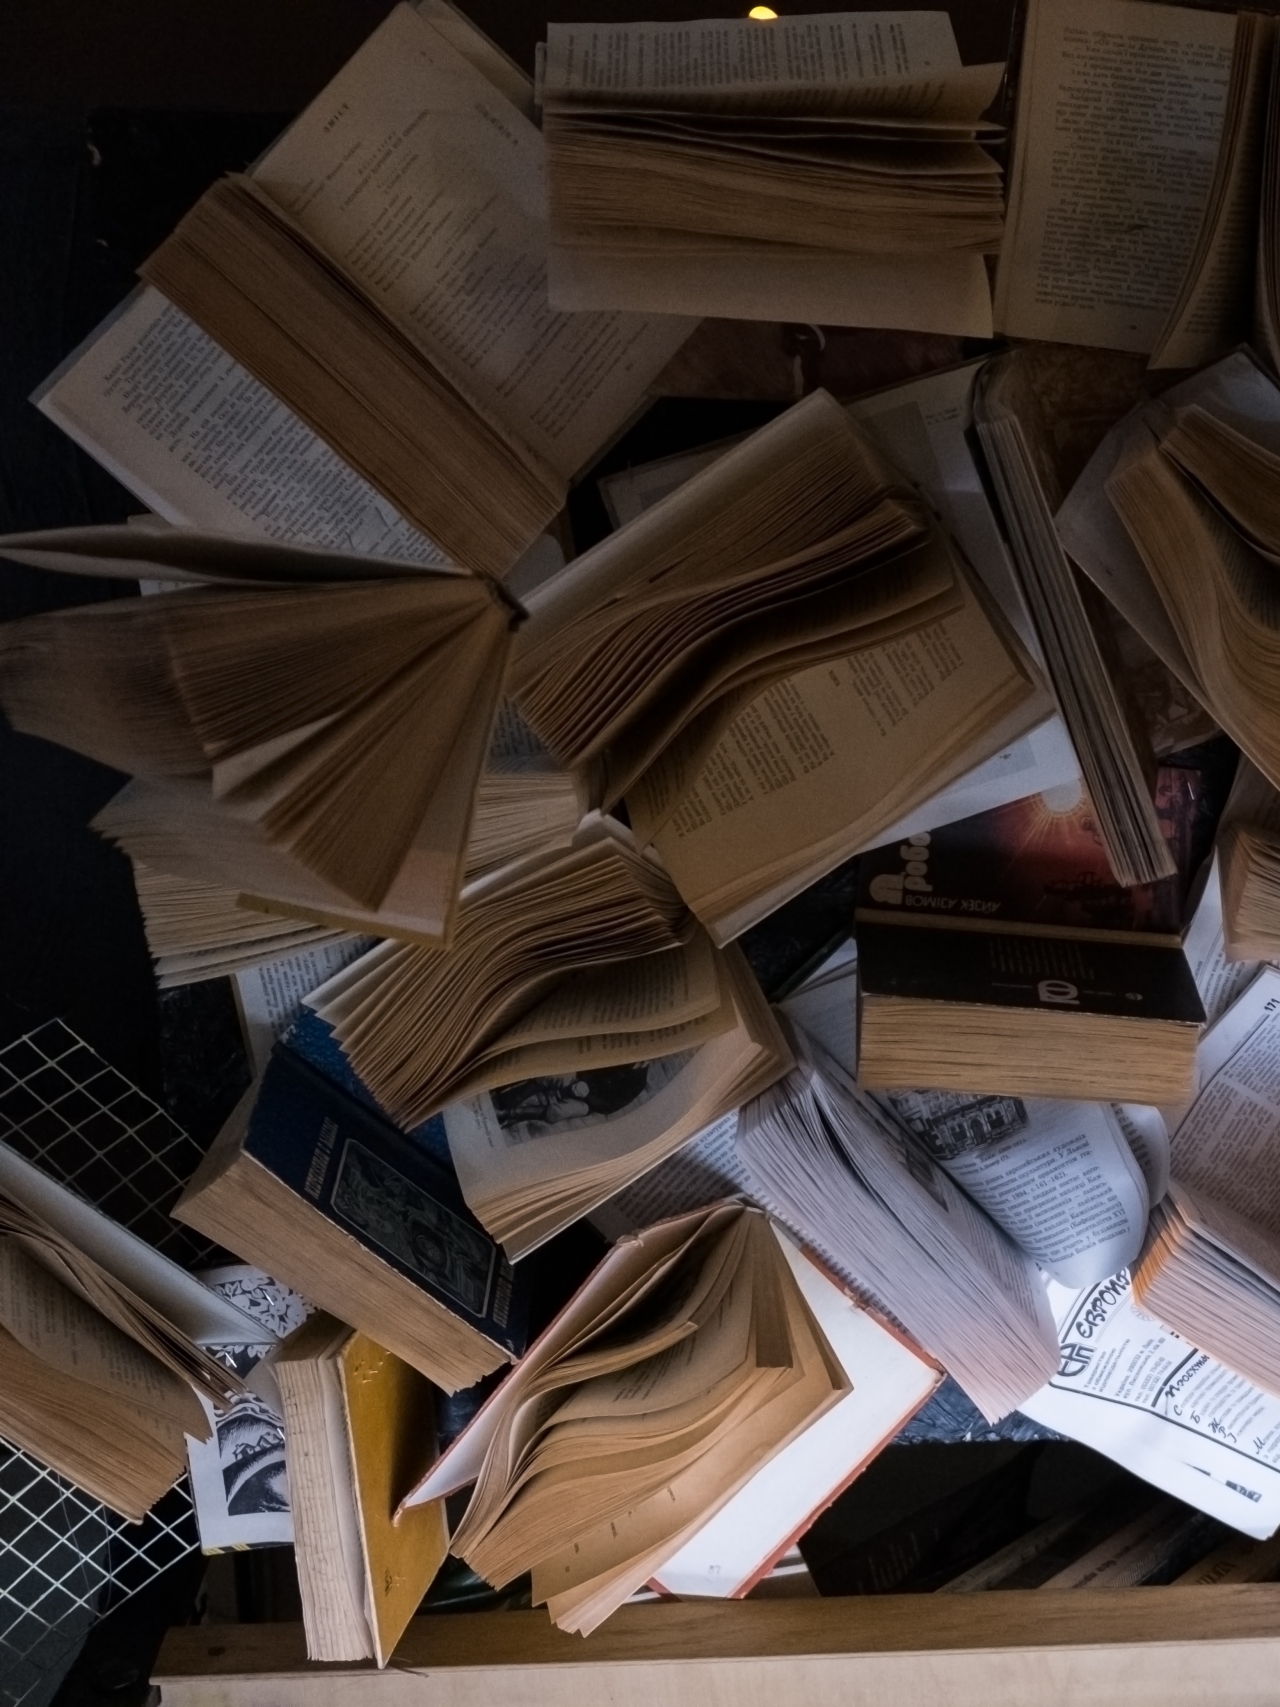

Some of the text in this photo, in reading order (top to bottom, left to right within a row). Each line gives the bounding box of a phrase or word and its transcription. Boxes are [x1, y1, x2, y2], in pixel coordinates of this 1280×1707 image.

[899, 831, 932, 891] робо
[904, 894, 1001, 912] АЙЗЕК АЗІМОВ
[1262, 995, 1280, 1014] 171
